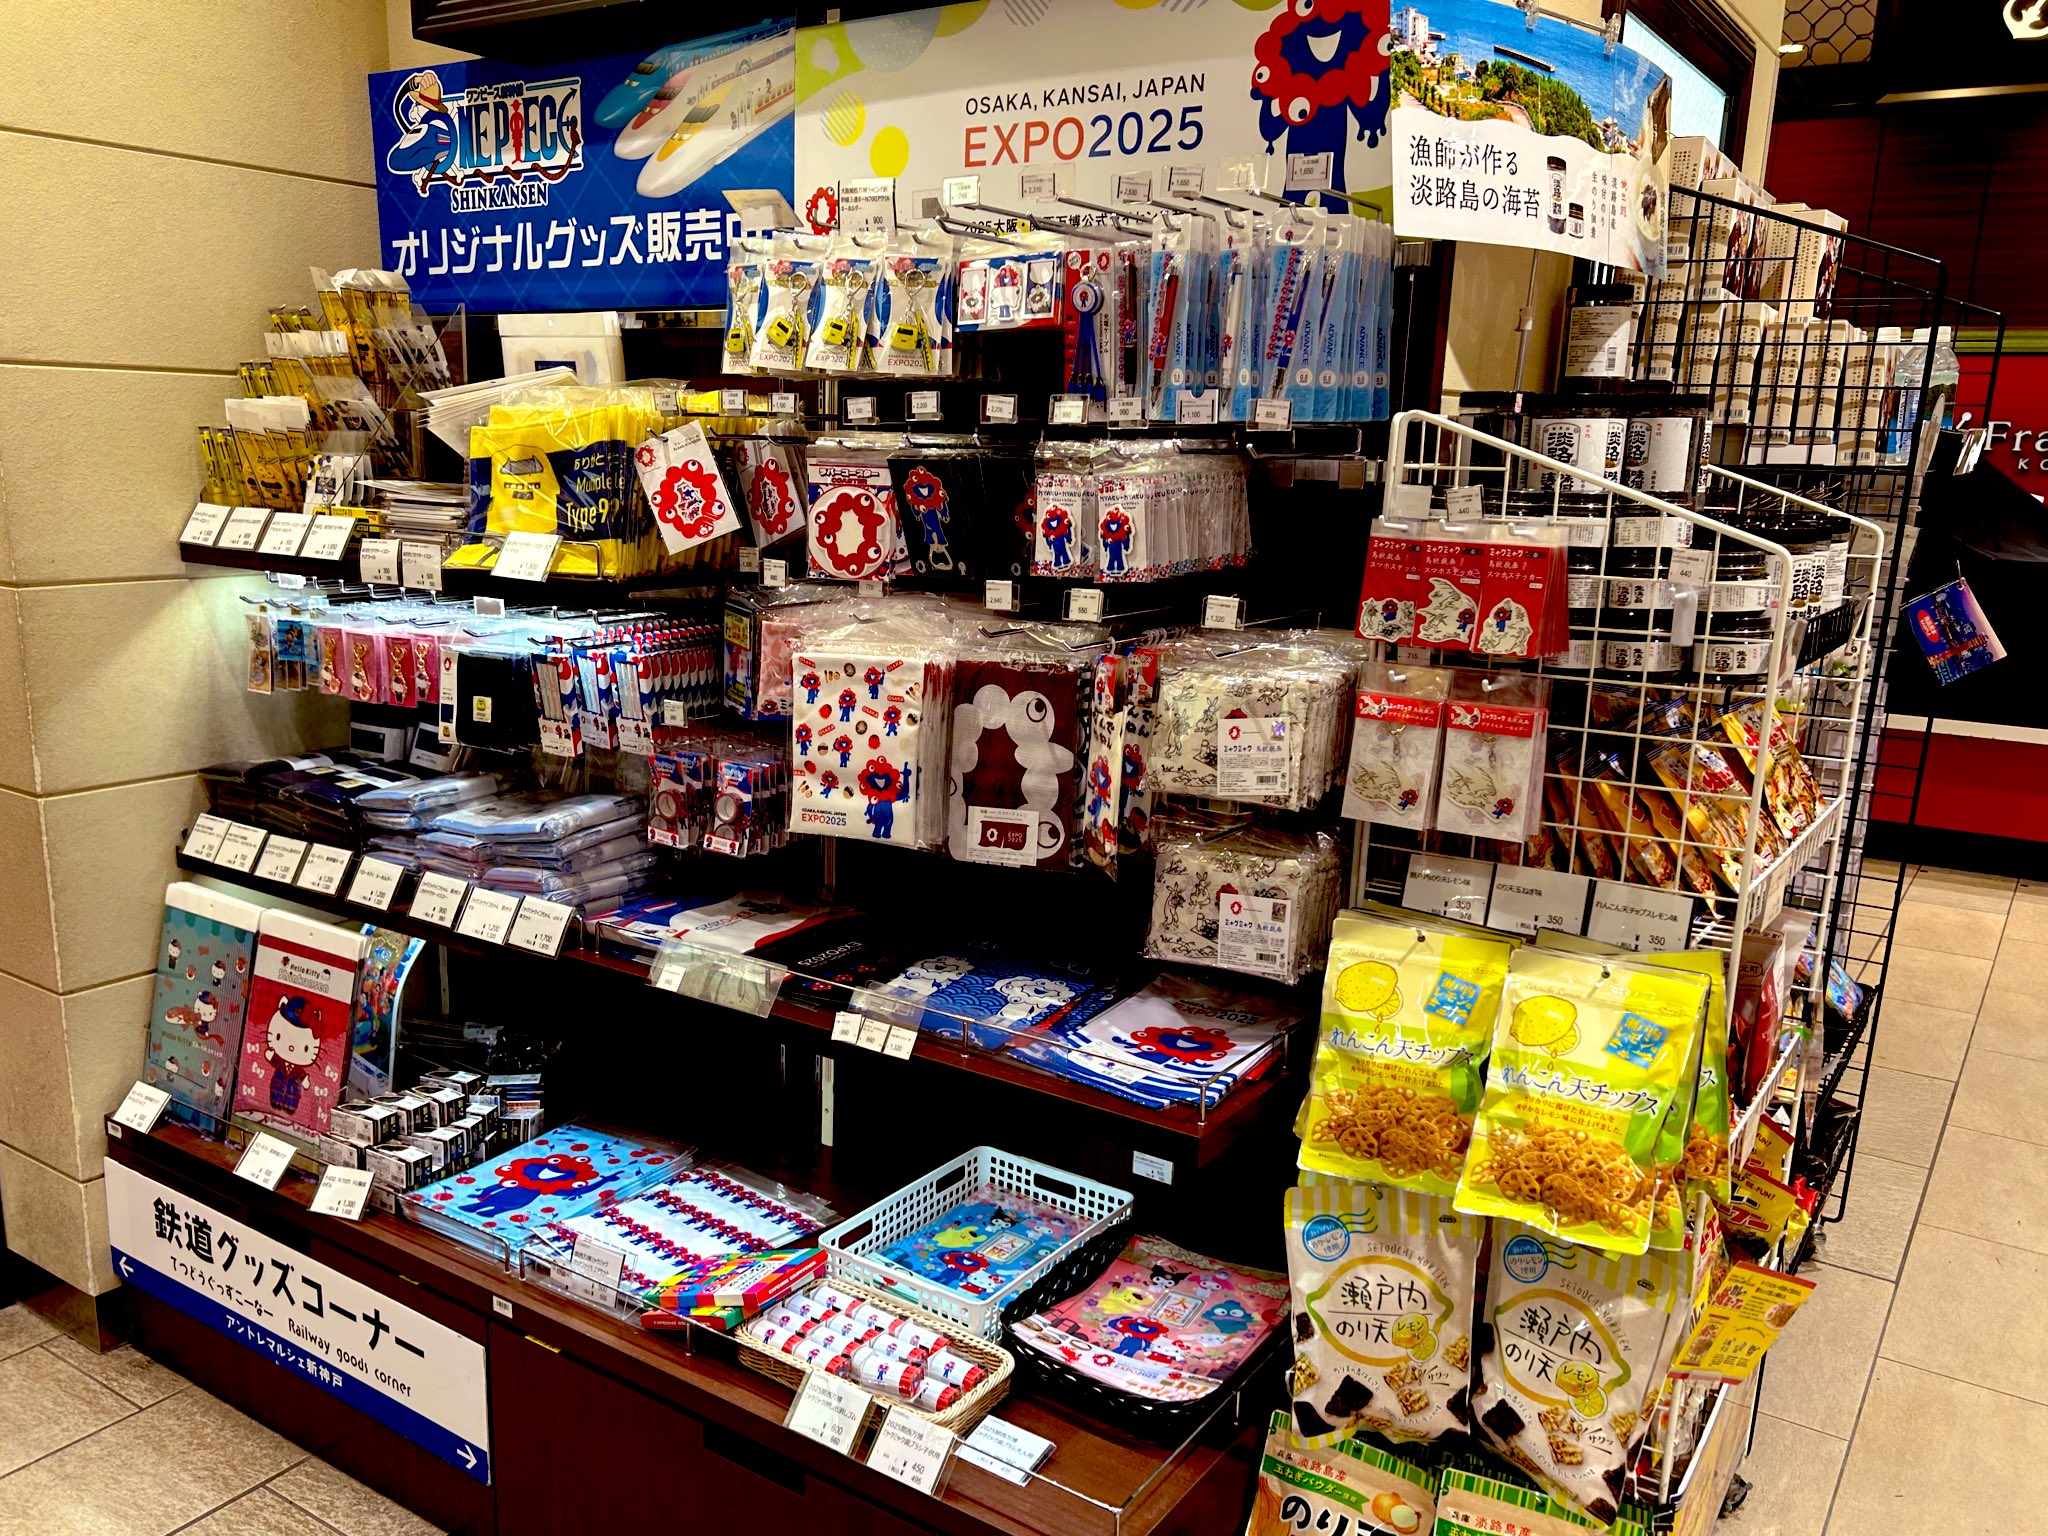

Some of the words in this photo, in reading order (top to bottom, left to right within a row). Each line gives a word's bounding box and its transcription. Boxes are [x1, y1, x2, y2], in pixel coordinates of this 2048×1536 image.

[965, 95, 1039, 117] OSAKA,
[1043, 83, 1127, 110] KANSAI,
[1132, 73, 1206, 101] JAPAN
[964, 105, 1204, 168] EXPO2025
[1410, 135, 1518, 176] 漁師が作る
[452, 183, 549, 212] SHINKANSEN
[1410, 174, 1540, 219] 淡路島の海苔
[888, 358, 925, 368] EXPO202
[566, 501, 597, 533] Type
[1458, 507, 1470, 515] 440
[1680, 569, 1692, 578] 440
[801, 813, 847, 826] EXPO2025
[1547, 914, 1563, 926] 350
[1648, 935, 1666, 946] 350
[797, 941, 864, 968] EXPO2025
[278, 970, 330, 994] Shinkansen
[290, 962, 304, 974] Hello
[305, 967, 320, 980] Kitty
[1172, 1001, 1262, 1025] EXPO2025
[1331, 1026, 1474, 1065] れんこん天チップス
[1502, 1063, 1659, 1116] れんこん天チップス
[1745, 1181, 1776, 1200] BE-FUN!
[153, 1196, 425, 1358] 鉄道グッズコーナー
[1367, 1243, 1414, 1260] SETOUCHI
[1417, 1256, 1450, 1289] NORITEN
[1341, 1274, 1428, 1311] 瀬戸内
[1336, 1318, 1389, 1343] のり天
[1397, 1321, 1425, 1332] レモン
[1520, 1306, 1601, 1365] 瀬戸内
[1603, 1310, 1632, 1352] NORITEN
[225, 1314, 343, 1390] アントレマルシェ新神戸
[288, 1318, 330, 1355] Railway
[337, 1348, 369, 1375] goods
[374, 1367, 412, 1398] corner
[1505, 1344, 1557, 1383] のり天
[1563, 1366, 1595, 1383] レモン
[830, 1435, 840, 1445] 660
[831, 1424, 843, 1435] 600
[912, 1462, 925, 1474] 450
[1276, 1450, 1294, 1463] 兵庫
[1298, 1455, 1347, 1483] 淡路島産
[911, 1475, 922, 1485] 495
[1450, 1510, 1470, 1524] 兵庫
[1475, 1515, 1533, 1536] 淡路島産
